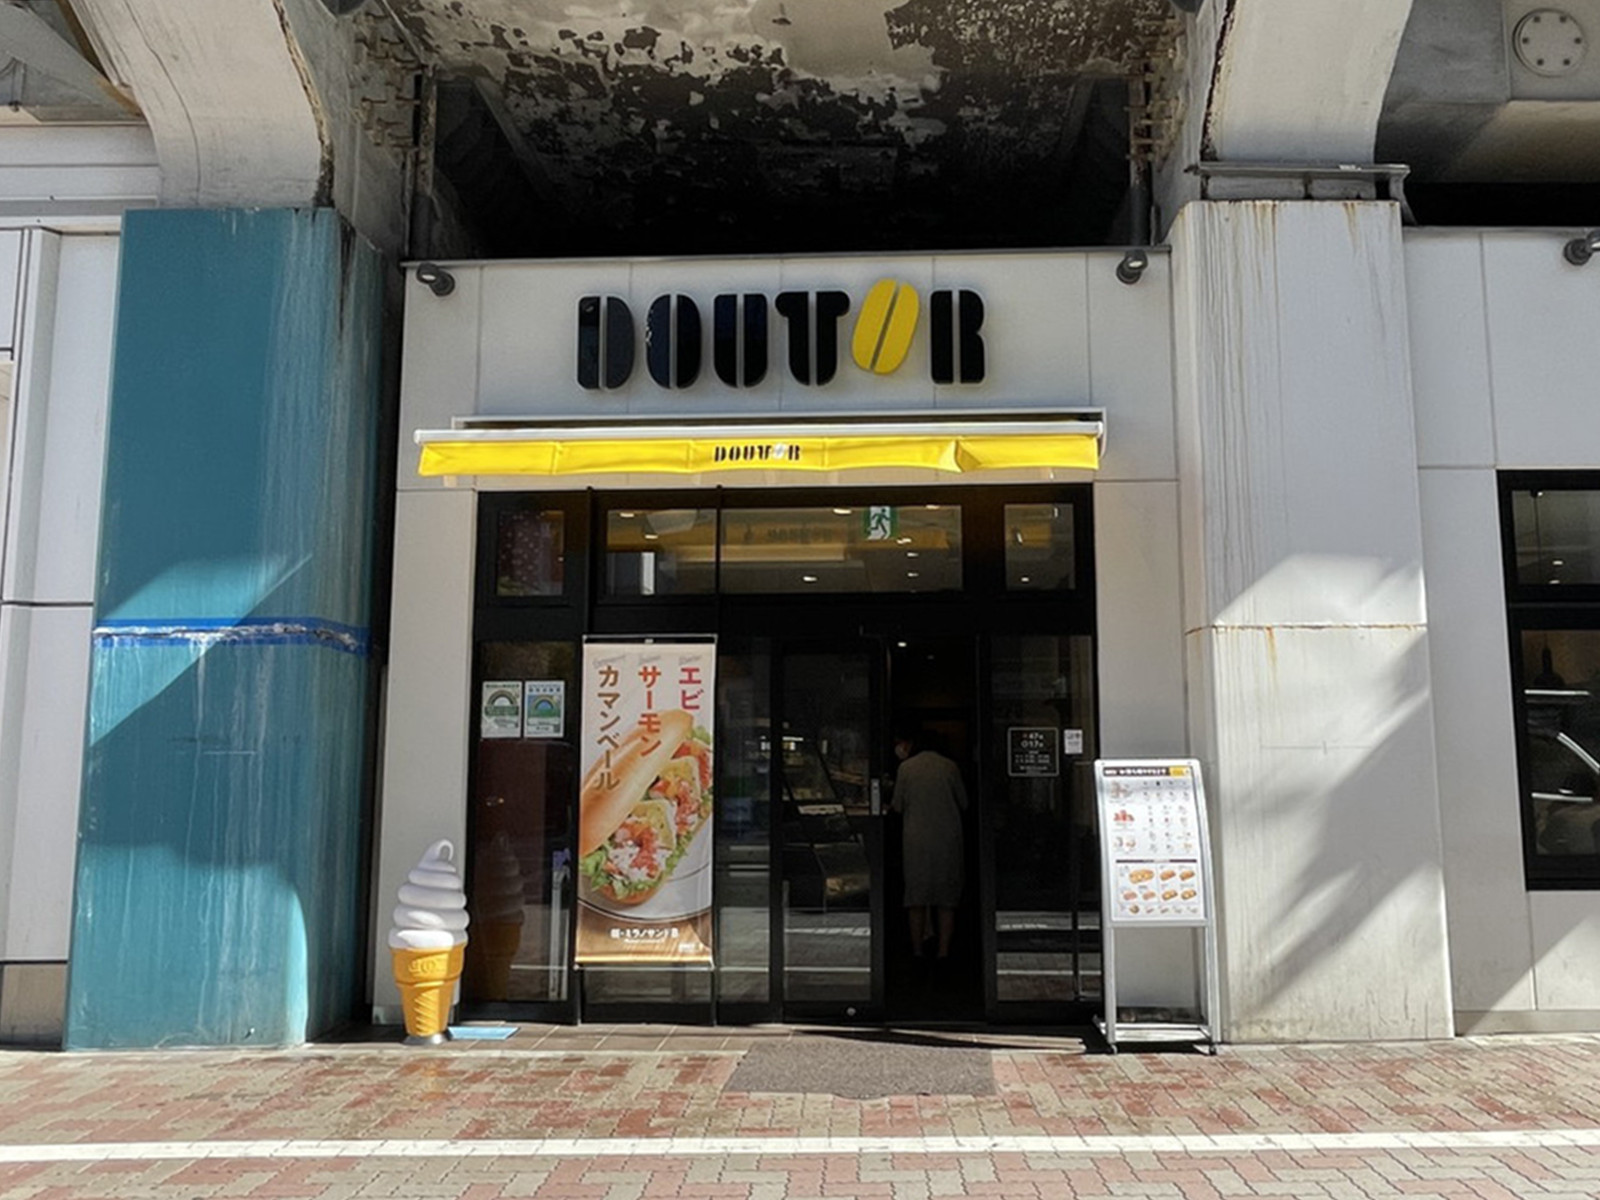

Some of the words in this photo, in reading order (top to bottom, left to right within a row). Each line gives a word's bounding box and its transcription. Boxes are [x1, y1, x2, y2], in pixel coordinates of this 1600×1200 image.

[577, 278, 986, 390] DOUTOR
[714, 442, 801, 462] DOUTOR
[597, 665, 621, 791] カマンベール
[638, 665, 662, 757] サーモン
[679, 667, 704, 710] エビ
